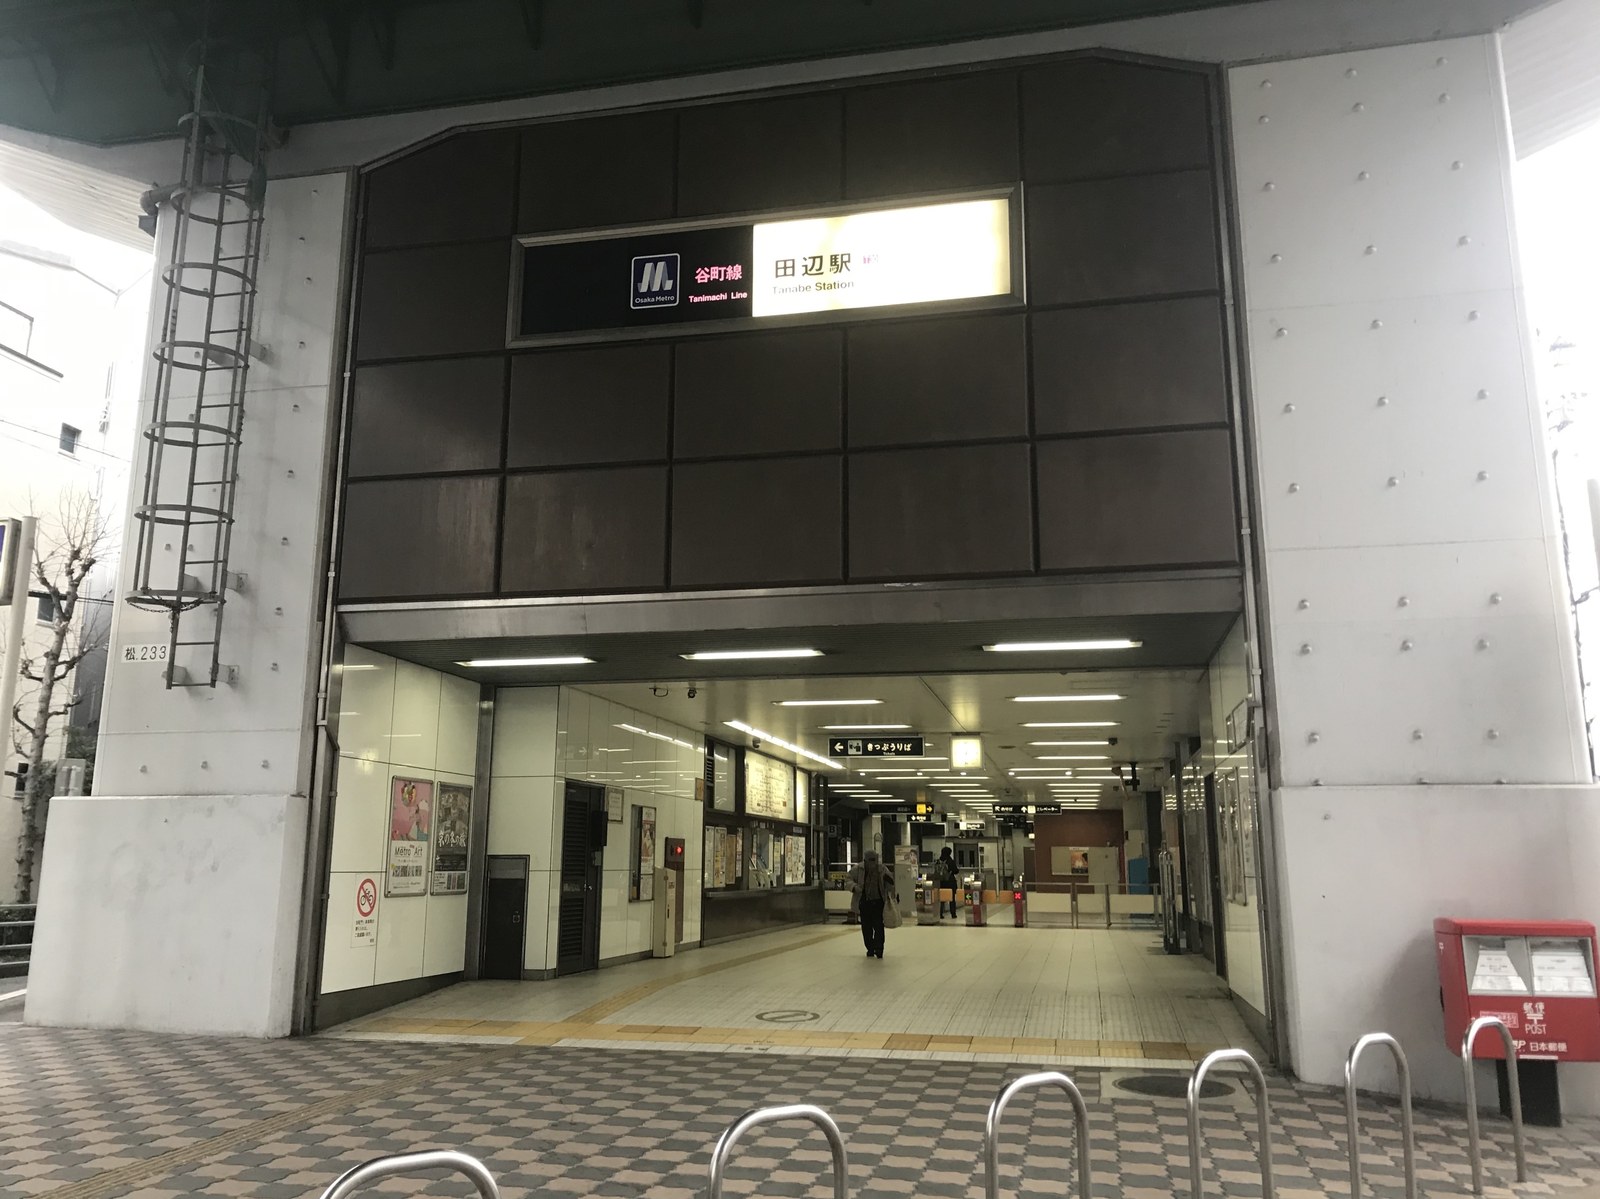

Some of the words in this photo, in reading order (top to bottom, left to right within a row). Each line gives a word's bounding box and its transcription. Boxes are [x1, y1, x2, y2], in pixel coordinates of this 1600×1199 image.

[775, 253, 852, 279] 田辺駅
[695, 264, 743, 284] 谷町線
[772, 282, 812, 295] Tanabe
[814, 279, 855, 291] Station
[634, 296, 655, 305] Osaka
[656, 295, 675, 304] Metro
[688, 293, 728, 304] Tanimachi
[731, 290, 748, 301] Line
[125, 645, 167, 662] 松.233
[866, 742, 912, 752] きっぷうりば
[413, 846, 423, 857] Art
[1524, 1023, 1547, 1035] POST
[1529, 1042, 1568, 1053] 日本郵便
